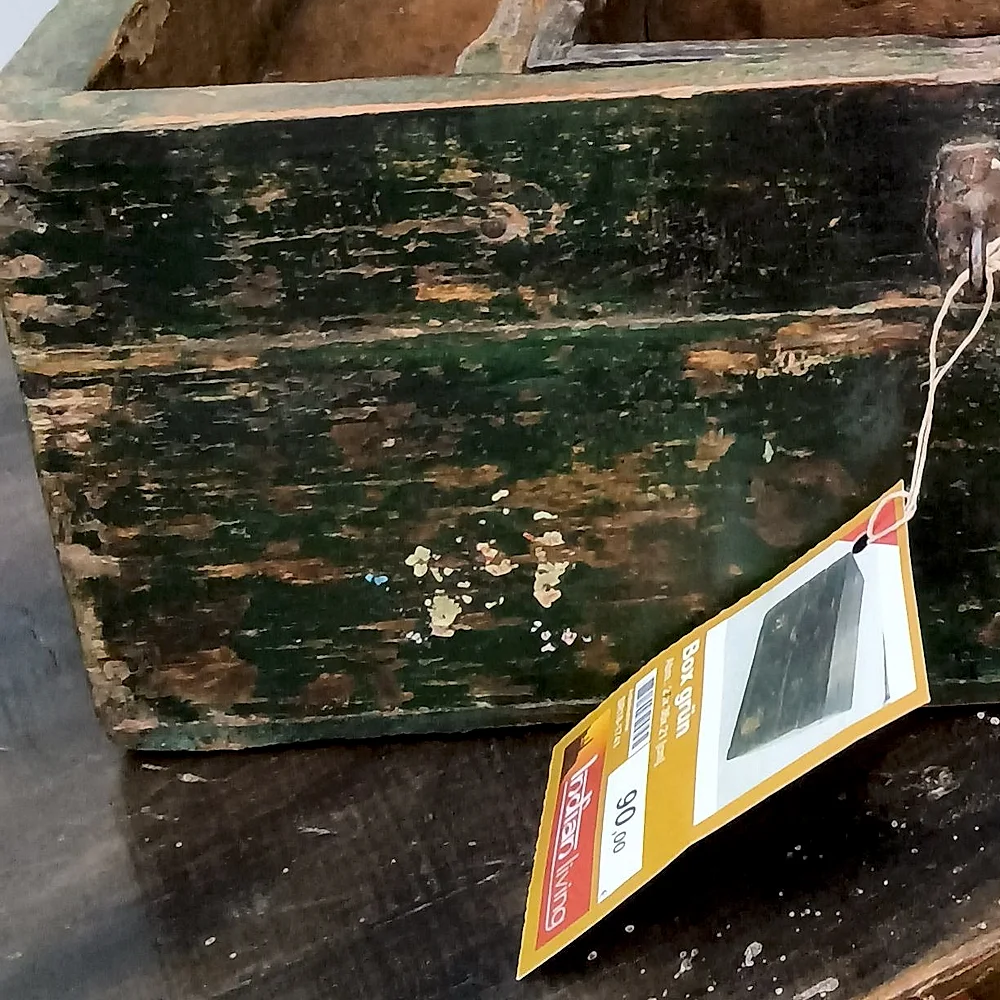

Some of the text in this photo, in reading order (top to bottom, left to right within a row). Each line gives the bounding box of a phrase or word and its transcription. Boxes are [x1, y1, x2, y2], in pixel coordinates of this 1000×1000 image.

[674, 639, 700, 739] Box grün
[546, 754, 599, 932] Indian living
[611, 789, 638, 854] 90,00
